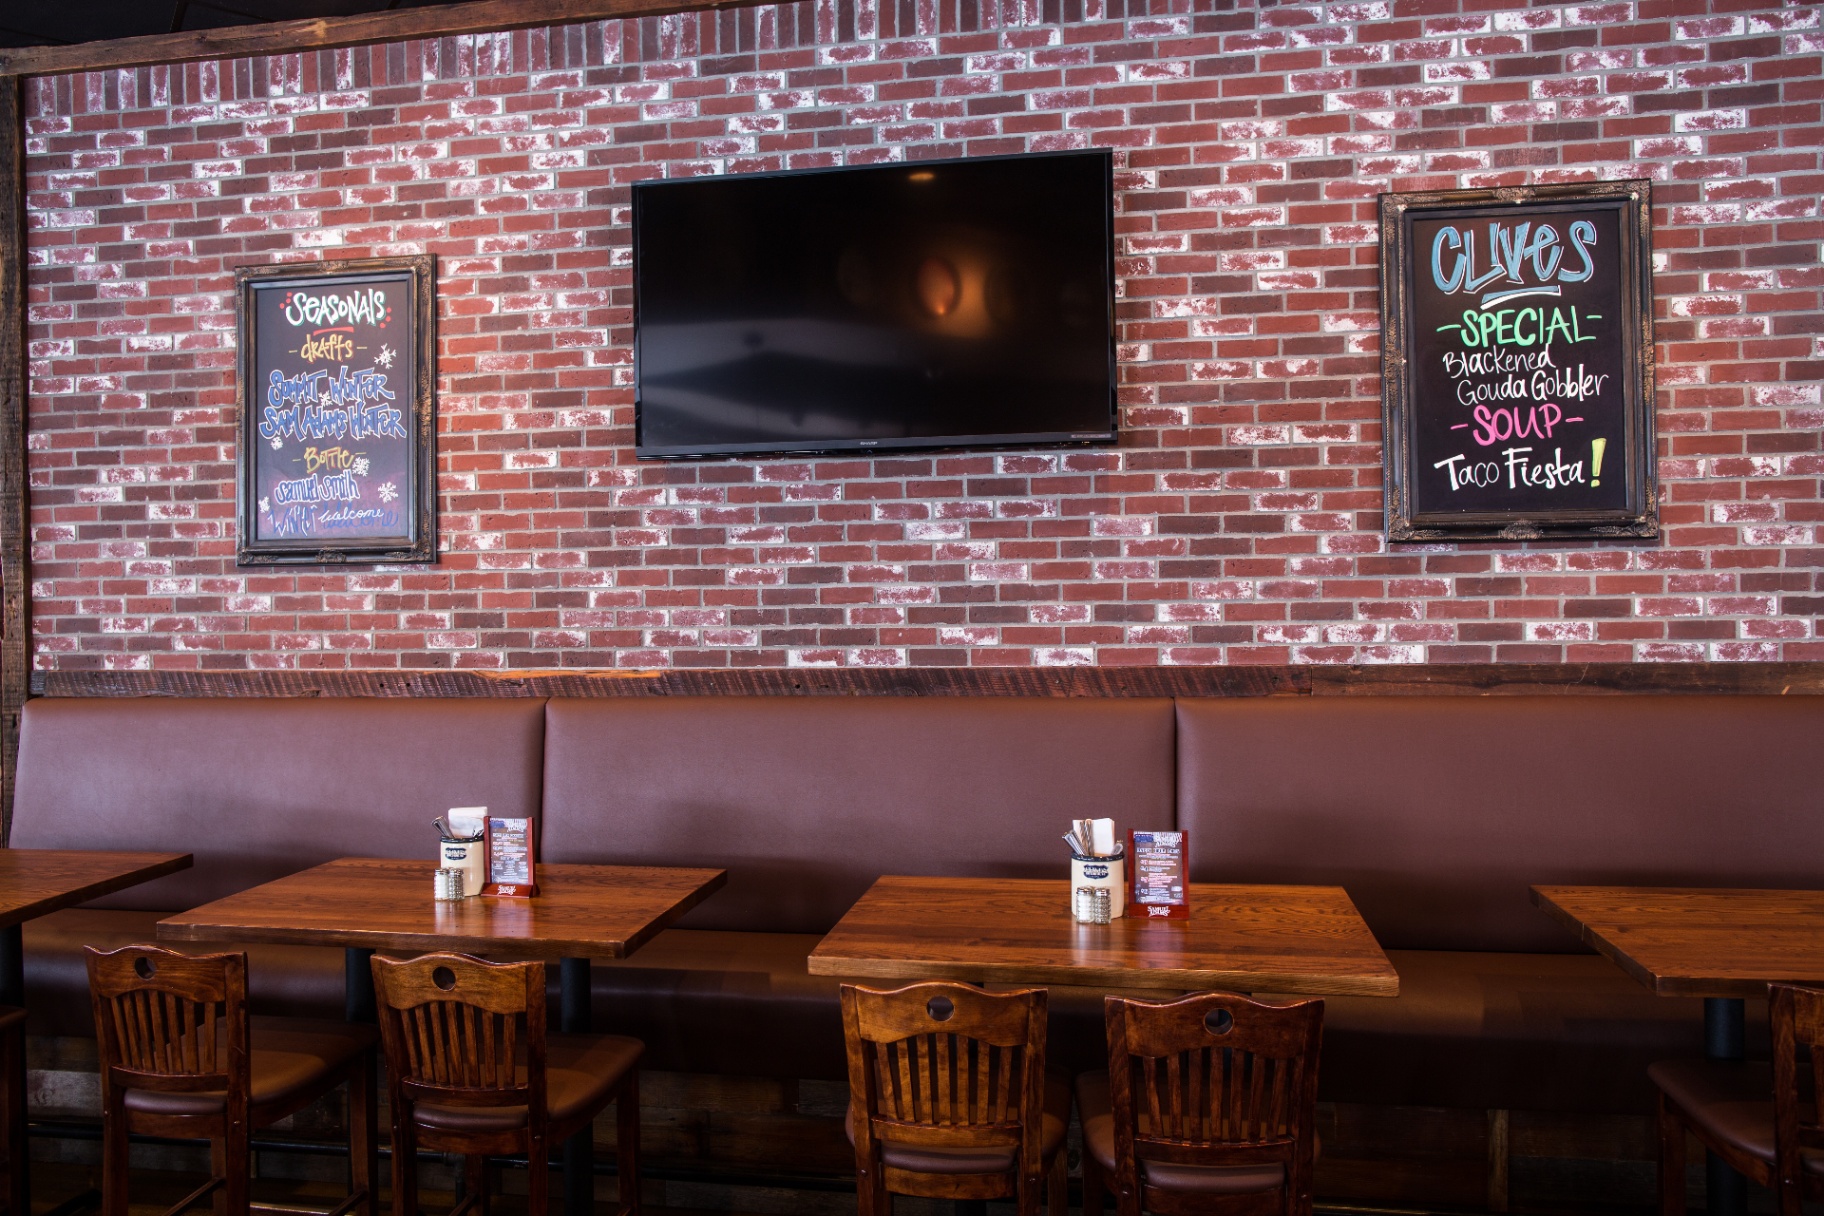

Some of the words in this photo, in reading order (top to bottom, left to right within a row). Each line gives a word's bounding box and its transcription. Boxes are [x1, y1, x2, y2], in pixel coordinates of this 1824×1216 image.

[1442, 343, 1557, 379] Blackened
[1456, 373, 1529, 406] Gouda
[1530, 363, 1610, 402] Gobbler
[1433, 453, 1500, 491] Taco
